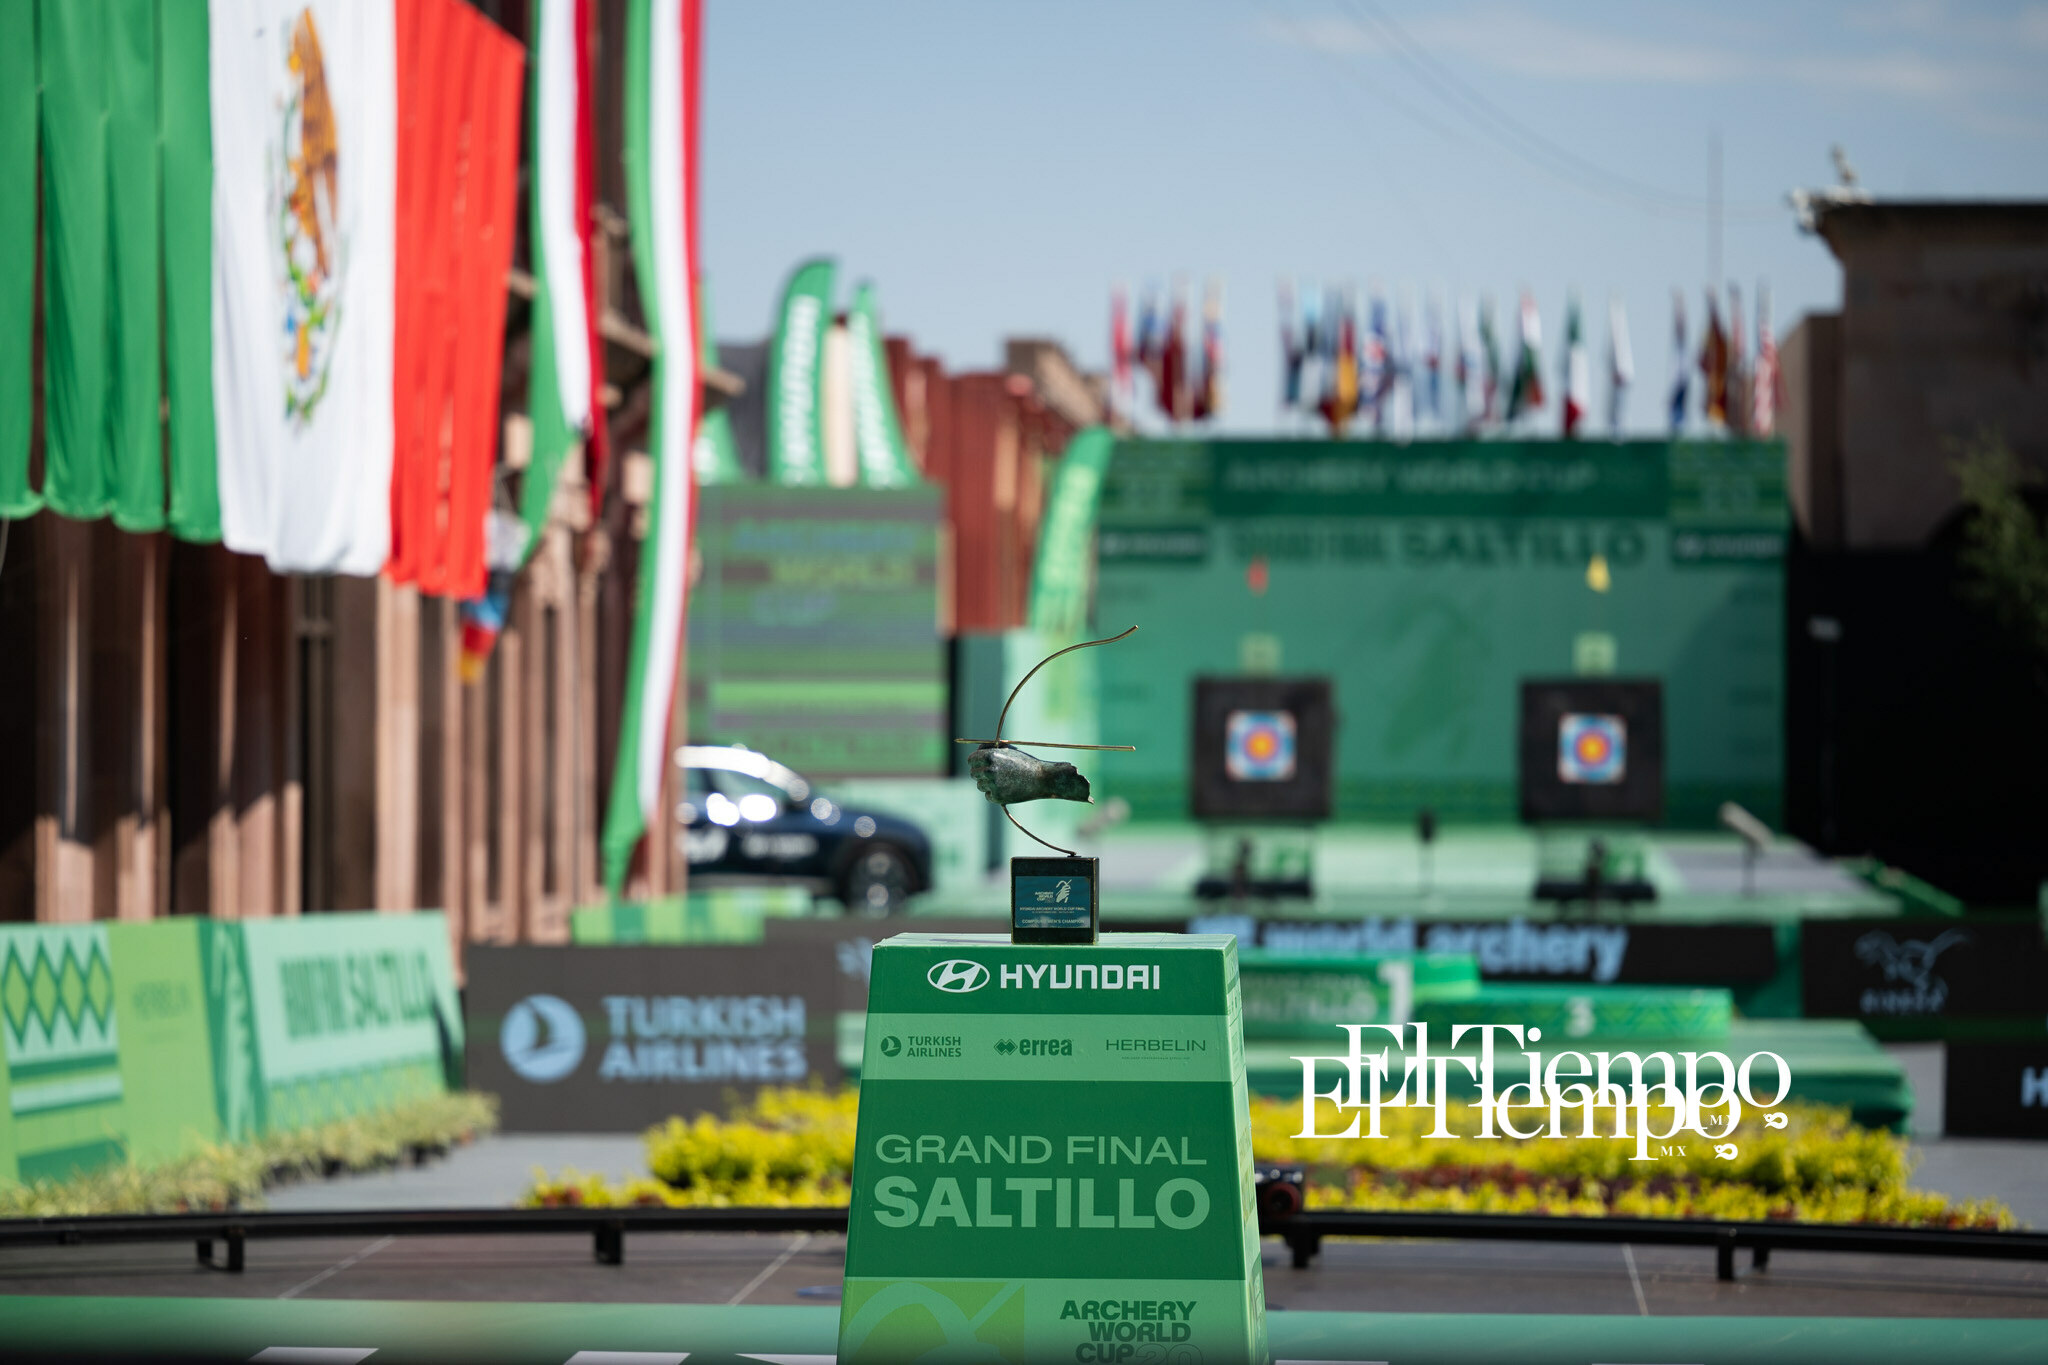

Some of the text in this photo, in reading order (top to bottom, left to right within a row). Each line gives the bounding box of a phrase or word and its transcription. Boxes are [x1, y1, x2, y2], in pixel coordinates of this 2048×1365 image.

[1000, 964, 1160, 990] HYUNDAI
[601, 994, 807, 1040] TURKISH
[907, 1036, 961, 1047] TURKISH
[907, 1047, 962, 1058] AIRLINES
[1105, 1039, 1206, 1052] HERBELIN
[599, 1040, 809, 1083] AIRLINES
[875, 1134, 1207, 1166] GRAND FINAL
[873, 1175, 1211, 1230] SALTILLO
[1059, 1299, 1198, 1321] ARCHERY
[1088, 1321, 1192, 1343] WORLD
[1075, 1342, 1135, 1364] CUP
